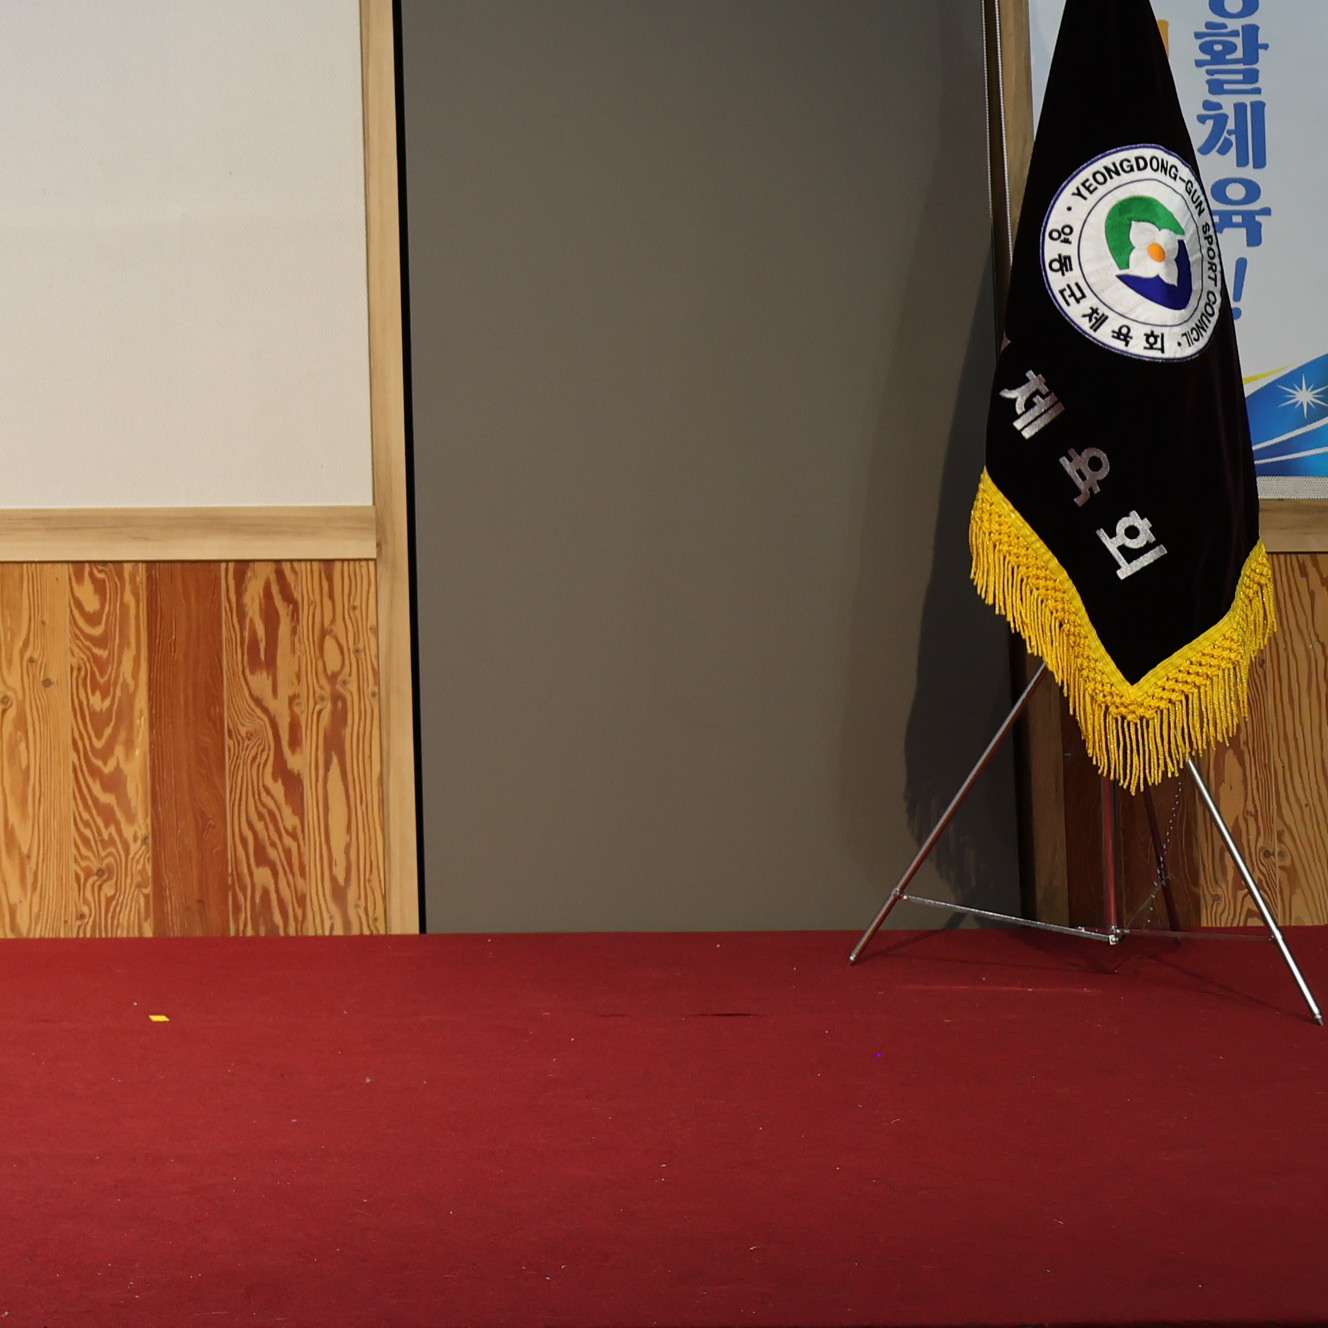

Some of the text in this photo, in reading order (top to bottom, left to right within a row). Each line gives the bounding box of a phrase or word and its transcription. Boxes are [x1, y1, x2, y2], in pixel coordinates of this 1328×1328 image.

[1048, 224, 1165, 354] 영동군체육회
[1071, 155, 1218, 347] YEONGDONG-GUN SPORT COUNCIL
[998, 369, 1169, 580] 체육회
